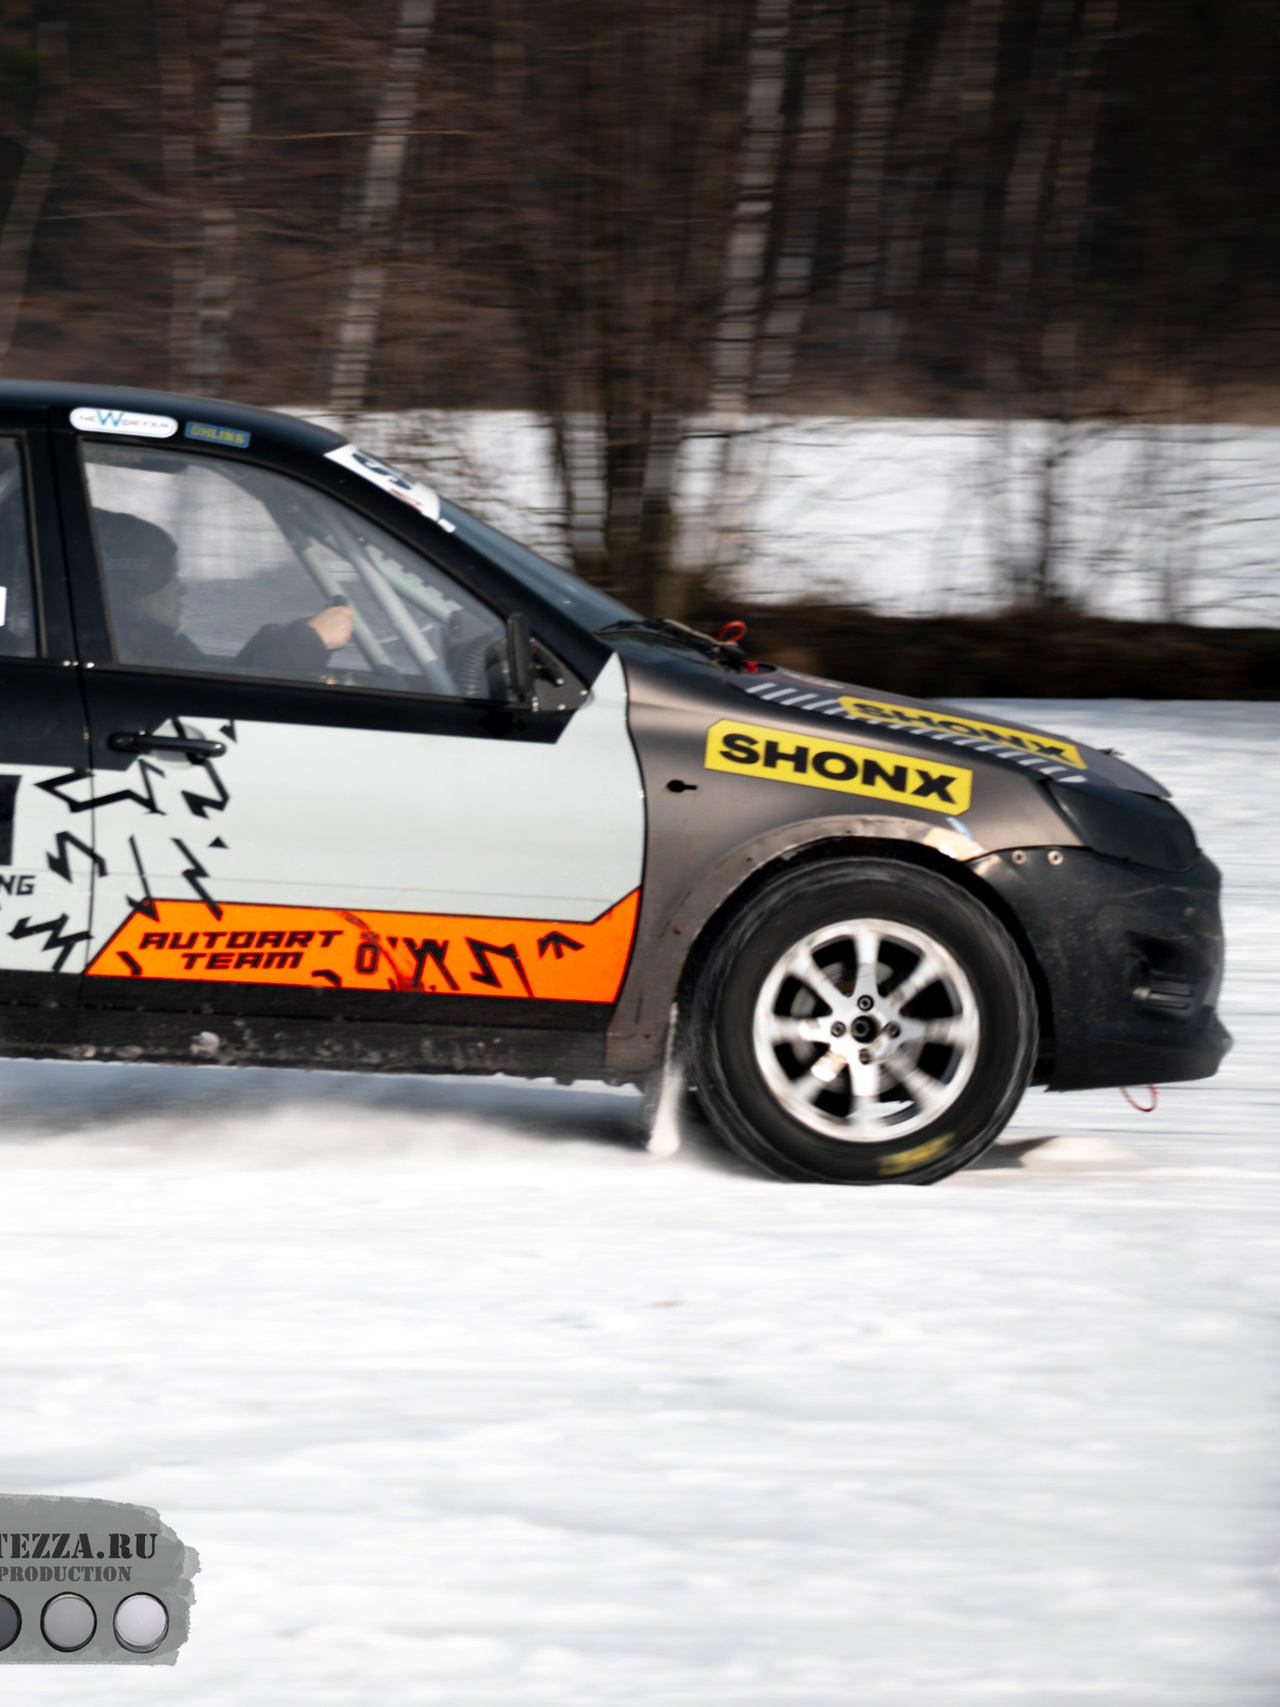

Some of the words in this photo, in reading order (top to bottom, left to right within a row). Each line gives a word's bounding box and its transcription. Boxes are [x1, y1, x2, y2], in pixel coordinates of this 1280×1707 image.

[719, 732, 958, 805] SHONX
[138, 930, 344, 950] AUTOART
[181, 951, 304, 970] TEAM
